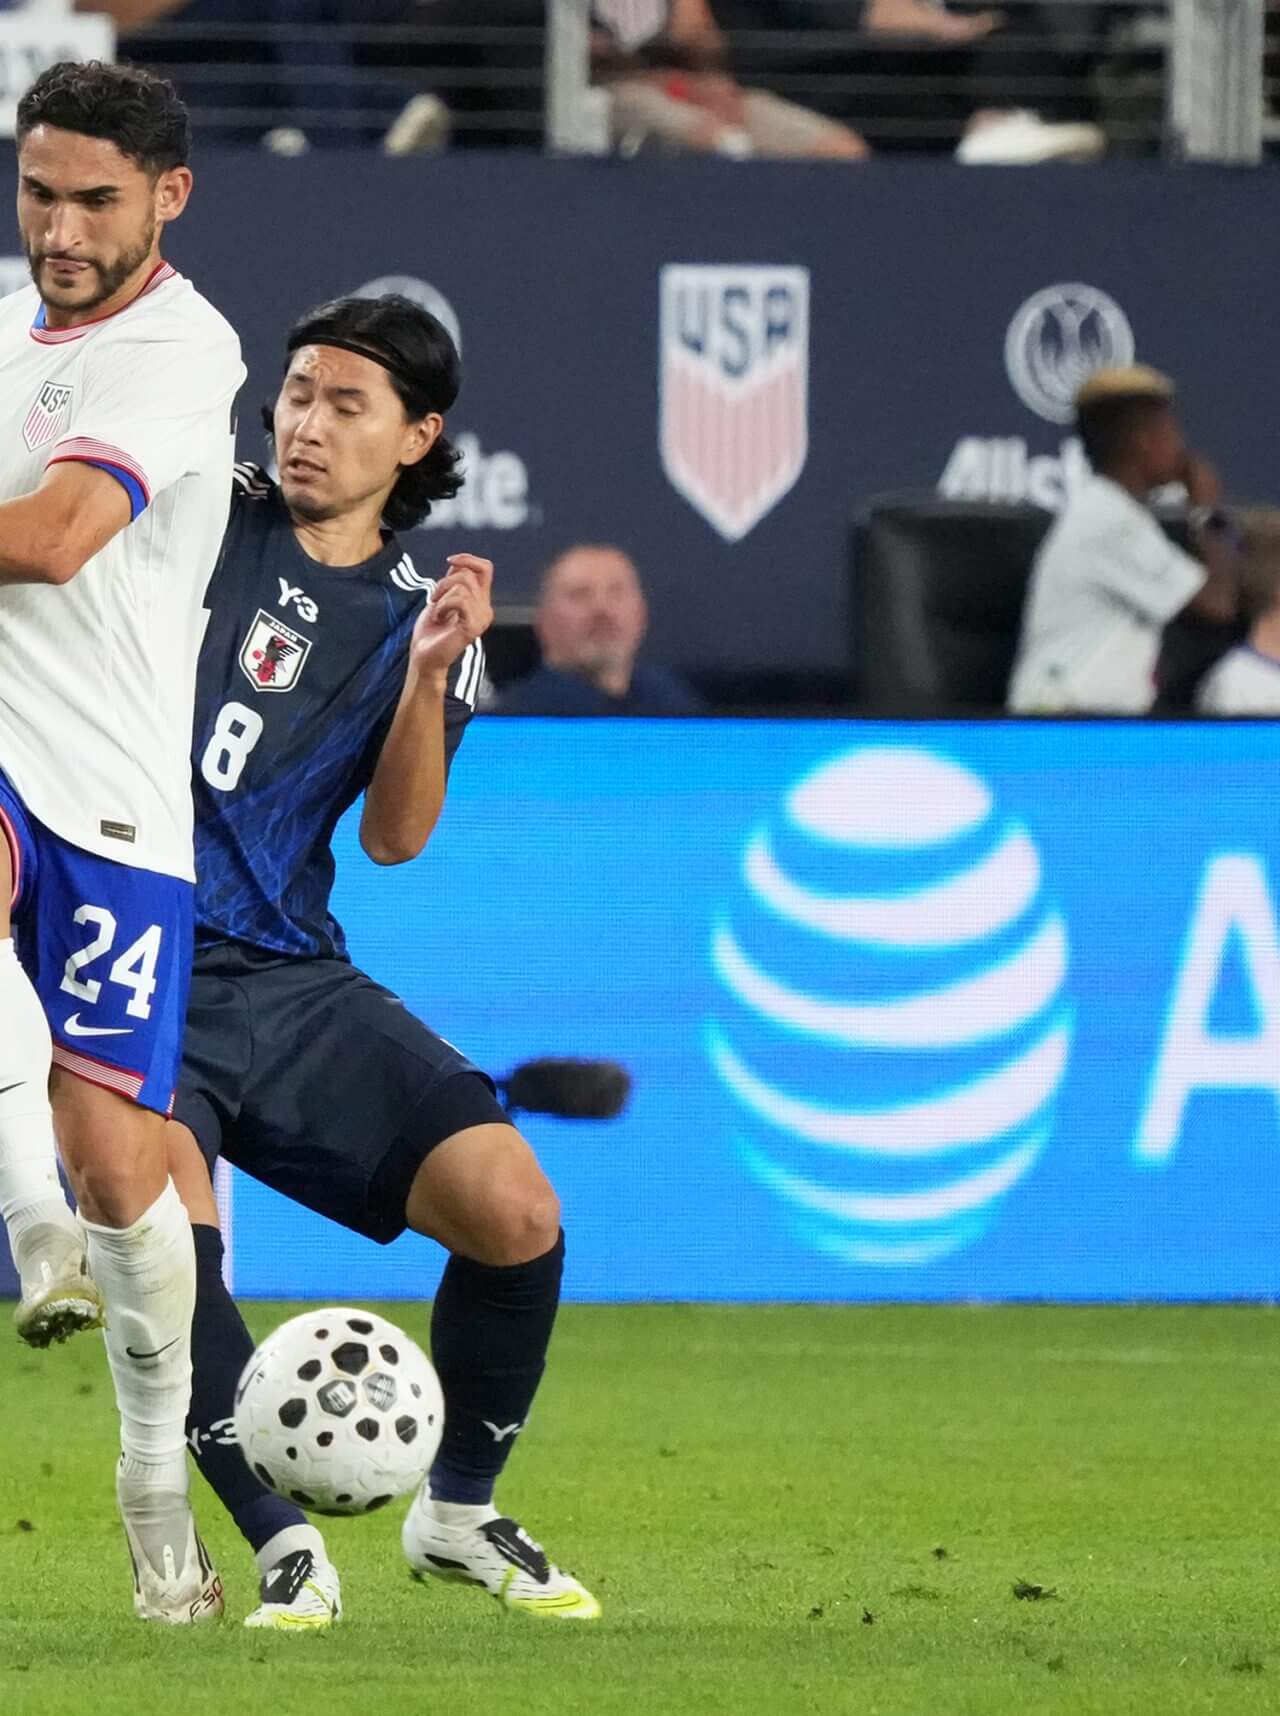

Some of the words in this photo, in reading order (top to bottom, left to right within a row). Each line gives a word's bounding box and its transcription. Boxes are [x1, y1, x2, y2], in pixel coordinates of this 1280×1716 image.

[677, 285, 792, 376] USA
[40, 384, 70, 413] USA
[269, 620, 299, 642] JAPAN
[278, 577, 319, 623] Y-3
[201, 701, 264, 791] 8
[60, 904, 162, 1019] 24
